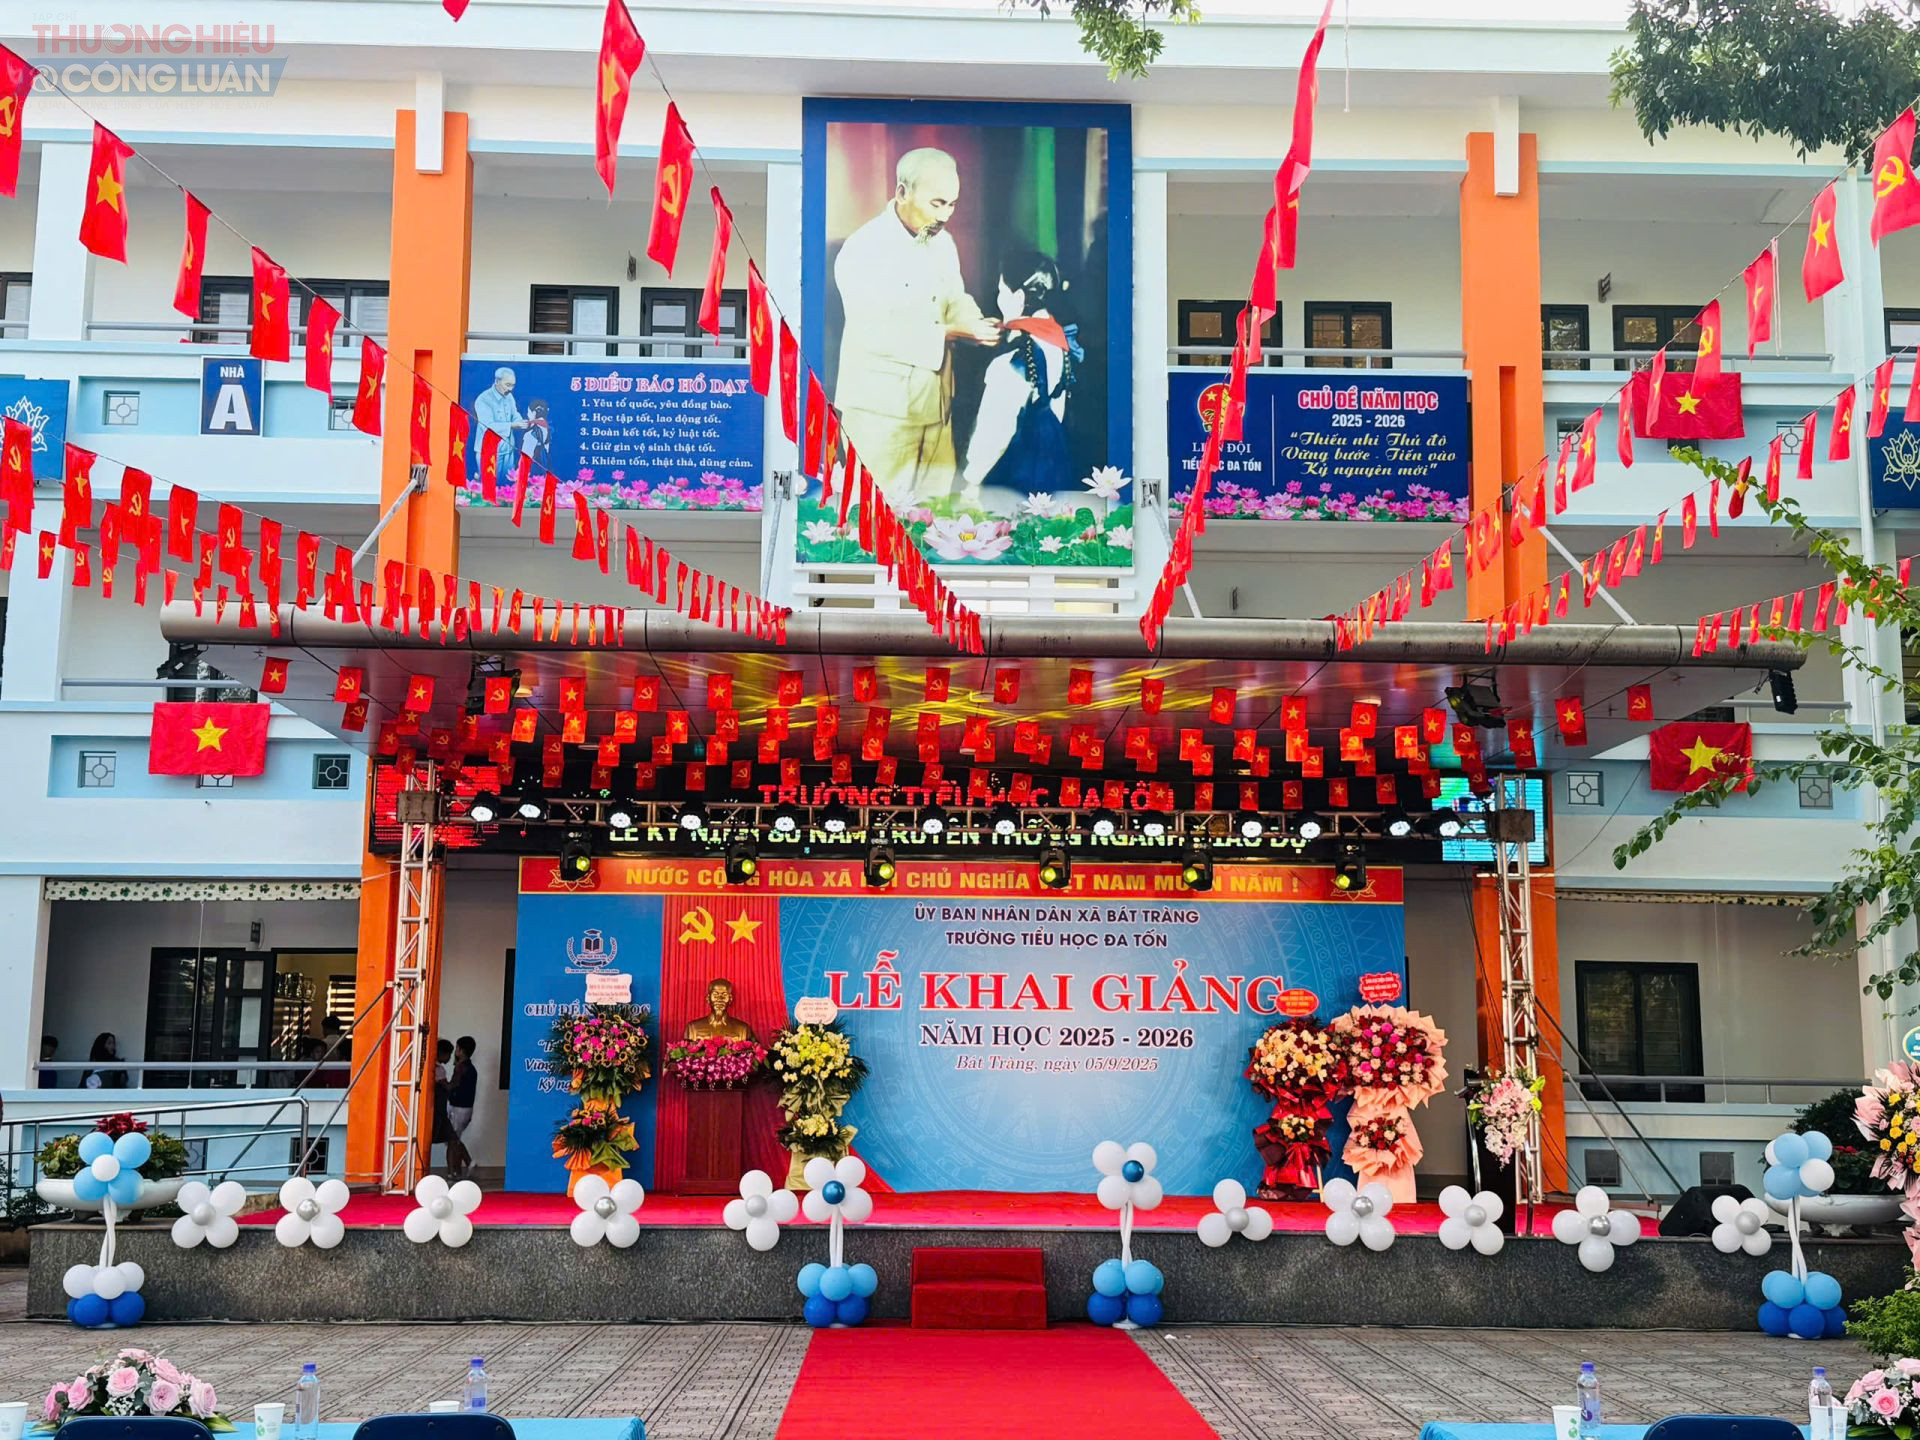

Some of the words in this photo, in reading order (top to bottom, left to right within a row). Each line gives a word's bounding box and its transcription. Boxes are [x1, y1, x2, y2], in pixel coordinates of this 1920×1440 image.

[220, 365, 245, 378] NHÀ
[570, 377, 582, 392] 5
[584, 371, 633, 393] ĐIỀU
[635, 374, 675, 393] BÁC
[677, 372, 707, 394] HỒ
[709, 378, 749, 397] DẠY
[209, 384, 253, 430] A
[581, 399, 591, 408] 1.
[592, 399, 613, 408] Yêu
[628, 398, 657, 411] quốc,
[659, 399, 679, 410] yêu
[681, 398, 708, 410] đồng
[1298, 385, 1333, 409] CHỦ
[1334, 385, 1359, 410] ĐỀ
[1360, 387, 1401, 411] NĂM
[1402, 391, 1439, 414] HỌC
[580, 413, 590, 422] 2.
[592, 413, 614, 425] Học
[616, 414, 634, 424] tập
[636, 412, 655, 424] tốt,
[656, 414, 673, 423] lao
[675, 414, 702, 425] động
[704, 413, 722, 424] tốt.
[1331, 413, 1364, 428] 2025
[1374, 414, 1406, 429] 2026
[580, 428, 590, 437] 3.
[592, 427, 621, 437] Đoàn
[623, 427, 641, 438] kết
[643, 427, 660, 439] tốt,
[678, 428, 700, 440] luật
[702, 428, 720, 438] tốt.
[1352, 433, 1380, 446] nhi
[1386, 433, 1422, 447] Thủ
[1426, 434, 1447, 447] đô
[579, 442, 589, 451] 4.
[591, 442, 612, 452] Giữ
[613, 443, 631, 453] gìn
[633, 443, 646, 454] vệ
[648, 443, 671, 452] sinh
[673, 443, 696, 455] thật
[698, 442, 716, 453] tốt.
[1226, 440, 1251, 456] ĐỘI
[1280, 447, 1330, 464] Vững
[1333, 447, 1371, 461] bước
[1385, 448, 1423, 462] Tiến
[1427, 449, 1457, 462] vào
[579, 456, 589, 466] 5.
[591, 457, 626, 467] Khiêm
[628, 456, 650, 469] tốn,
[652, 457, 674, 469] thật
[699, 457, 727, 470] dũng
[728, 457, 754, 467] cảm.
[1226, 460, 1241, 472] ĐA
[1242, 457, 1262, 472] TỐN
[1333, 463, 1393, 478] nguyên
[985, 787, 1050, 808] HC
[626, 866, 690, 886] NƯỚC
[697, 866, 760, 889] CỘG
[768, 867, 815, 887] HÒA
[821, 869, 853, 888] XÃ
[906, 868, 951, 889] CHỦ
[959, 870, 1031, 890] NGHĨA
[1093, 874, 1143, 891] NAM
[1151, 875, 1221, 893] MUN
[1227, 873, 1284, 892] NĂM
[915, 902, 936, 922] ỦY
[941, 907, 977, 922] BAN
[981, 904, 1031, 922] NHÂN
[1036, 905, 1073, 922] DÂN
[1077, 906, 1102, 923] XÃ
[1106, 906, 1138, 923] BÁT
[1142, 907, 1200, 924] TRÀNG
[946, 928, 1017, 946] TRƯỜNG
[1021, 926, 1054, 946] TIỂU
[1059, 933, 1099, 950] HỌC
[1103, 933, 1129, 947] ĐA
[1132, 929, 1168, 947] TỐN
[825, 950, 903, 1010] LỄ
[920, 972, 1074, 1011] KHAI
[1091, 960, 1285, 1015] GIẢNG
[524, 999, 556, 1017] CHỦ
[558, 999, 579, 1018] ĐỀ
[920, 1019, 983, 1046] NĂM
[991, 1026, 1051, 1051] HỌC
[1059, 1027, 1115, 1047] 2025
[1136, 1028, 1194, 1048] 2026
[956, 1055, 983, 1069] Bát
[989, 1055, 1038, 1072] Tràng,
[1043, 1057, 1080, 1073] ngày
[1085, 1057, 1159, 1071] 05/9/2025
